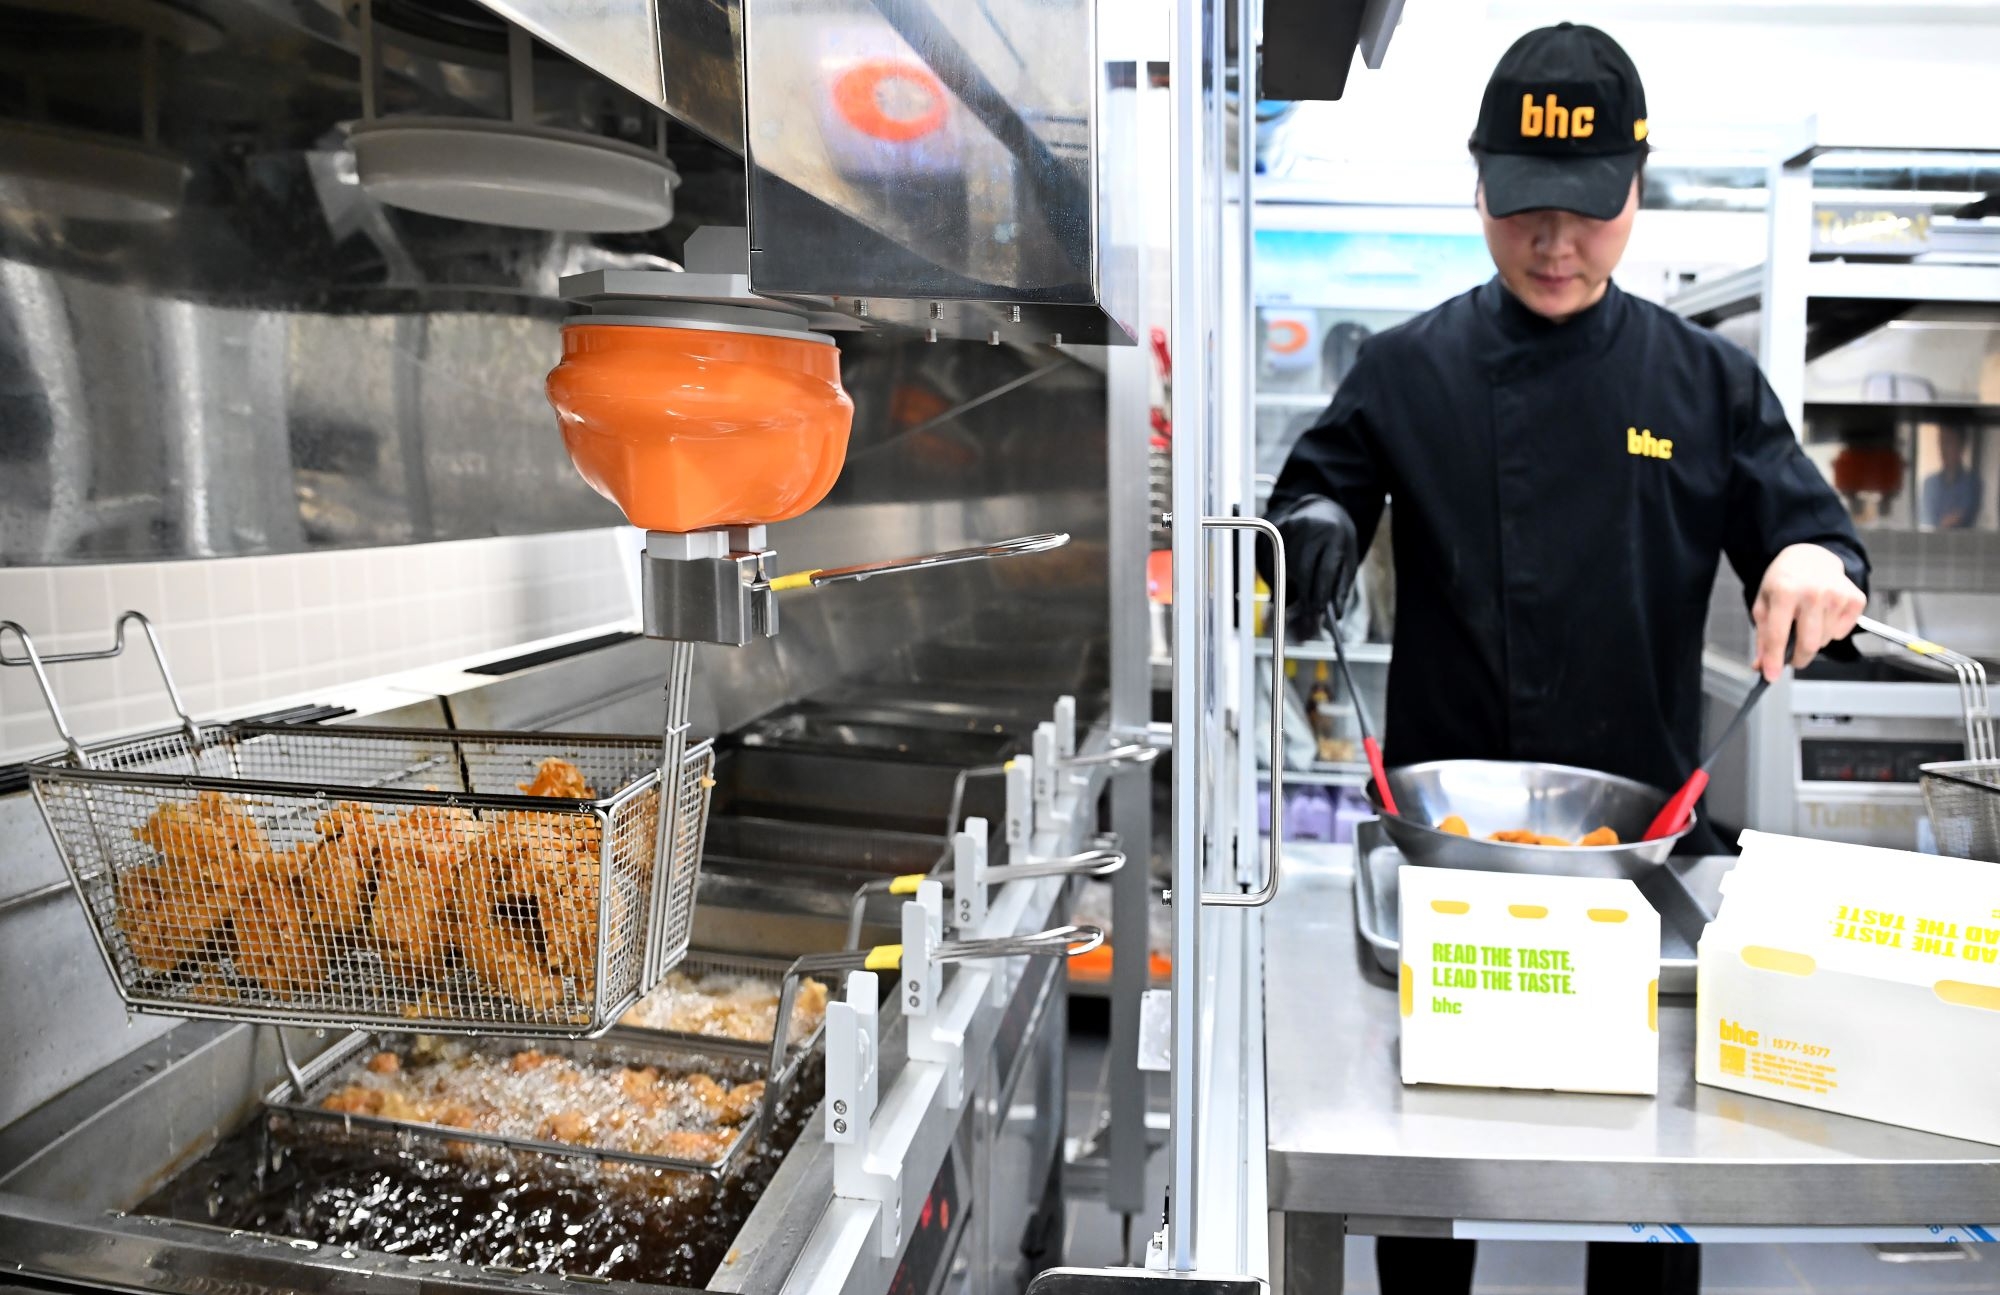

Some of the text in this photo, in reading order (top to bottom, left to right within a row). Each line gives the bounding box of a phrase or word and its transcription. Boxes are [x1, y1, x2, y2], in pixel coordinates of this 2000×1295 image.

[1520, 93, 1595, 138] bhc
[1627, 426, 1673, 460] bhc
[1914, 917, 1959, 939] THE
[1432, 942, 1477, 965] READ
[1480, 946, 1513, 967] THE
[1911, 935, 1956, 958] THE
[1432, 966, 1576, 994] LEAD THE TASTE.
[1432, 996, 1462, 1014] bhc
[1719, 1017, 1831, 1059] bhc 1577-5577
